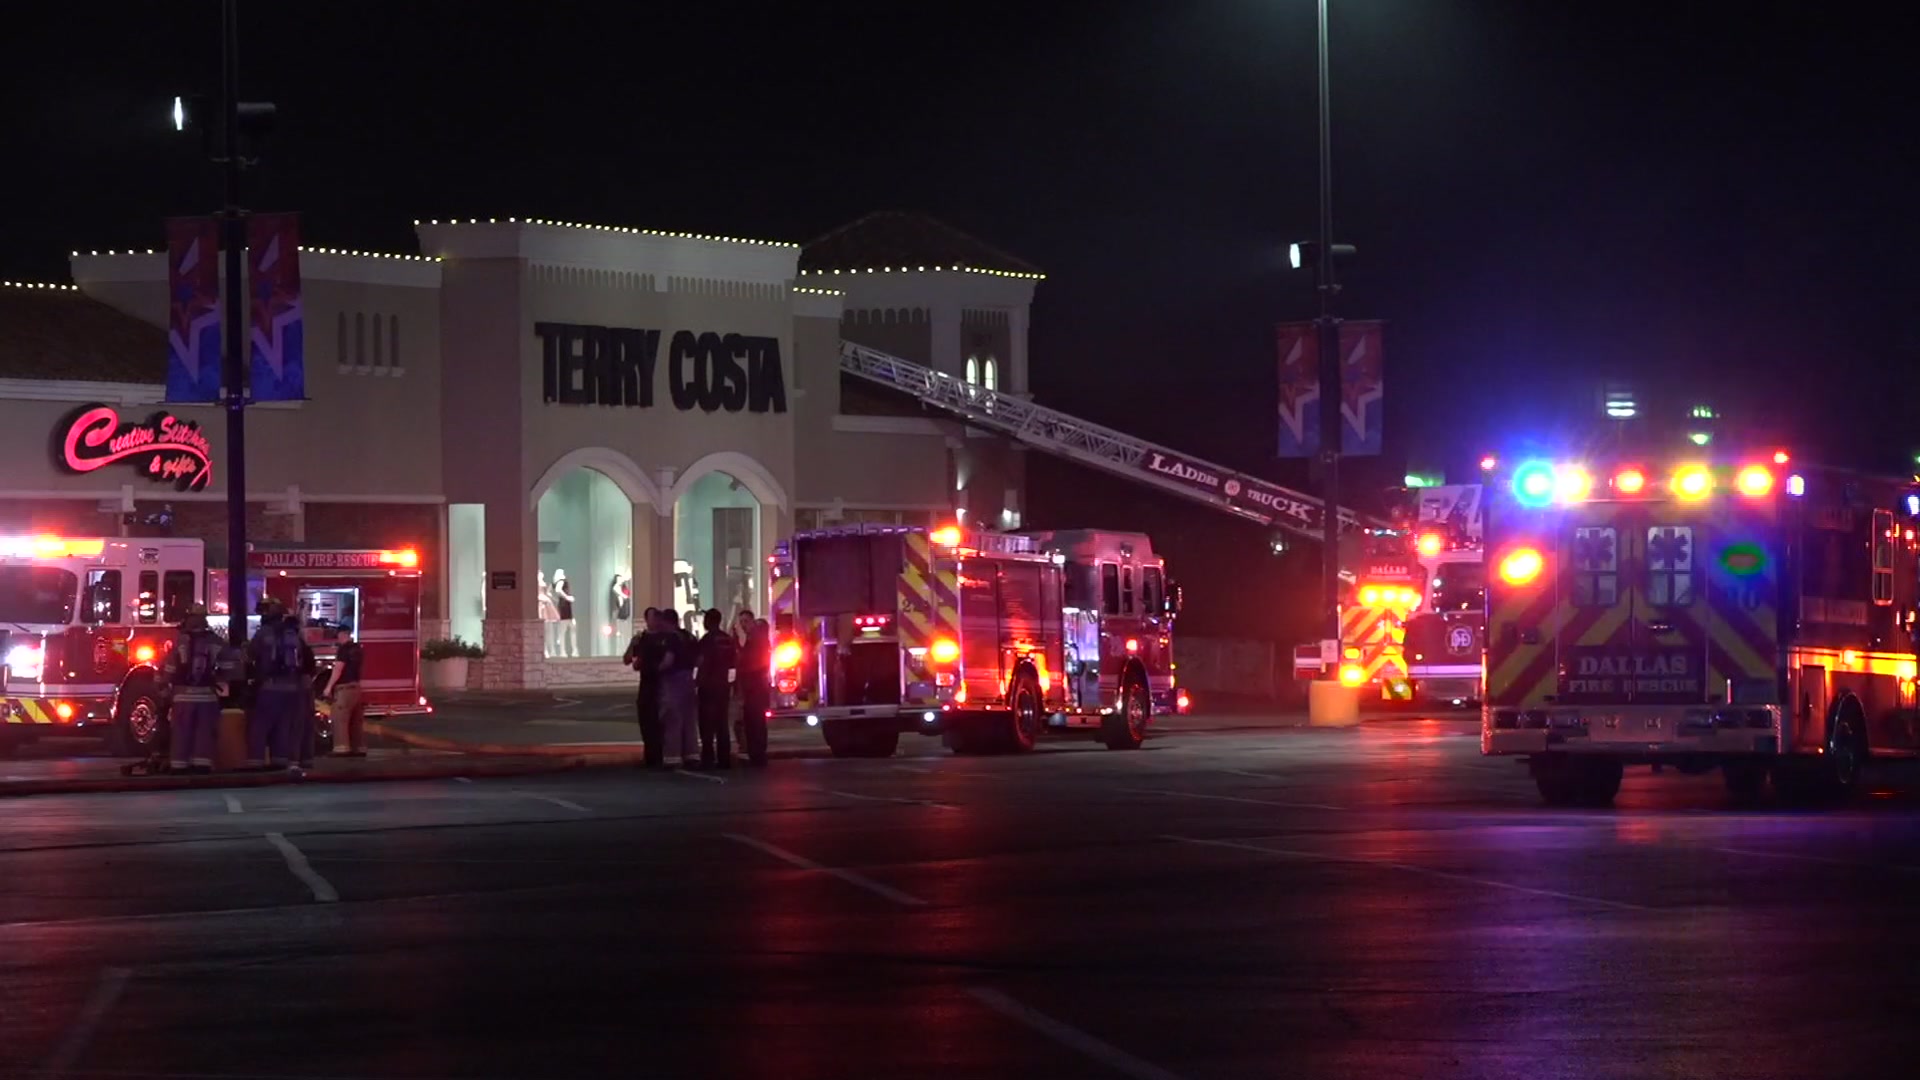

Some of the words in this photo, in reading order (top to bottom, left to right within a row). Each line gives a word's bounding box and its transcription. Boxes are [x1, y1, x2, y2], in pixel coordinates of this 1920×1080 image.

[534, 322, 661, 408] TERRY
[669, 330, 787, 413] COSTA
[64, 407, 154, 472] Creative
[149, 455, 161, 473] &
[1149, 453, 1219, 487] LADDER
[1247, 489, 1314, 523] TRUCK
[264, 553, 306, 567] DALLAS
[1578, 655, 1688, 676] DALLAS
[1568, 679, 1615, 693] FIRE
[1623, 679, 1699, 693] RESCUE
